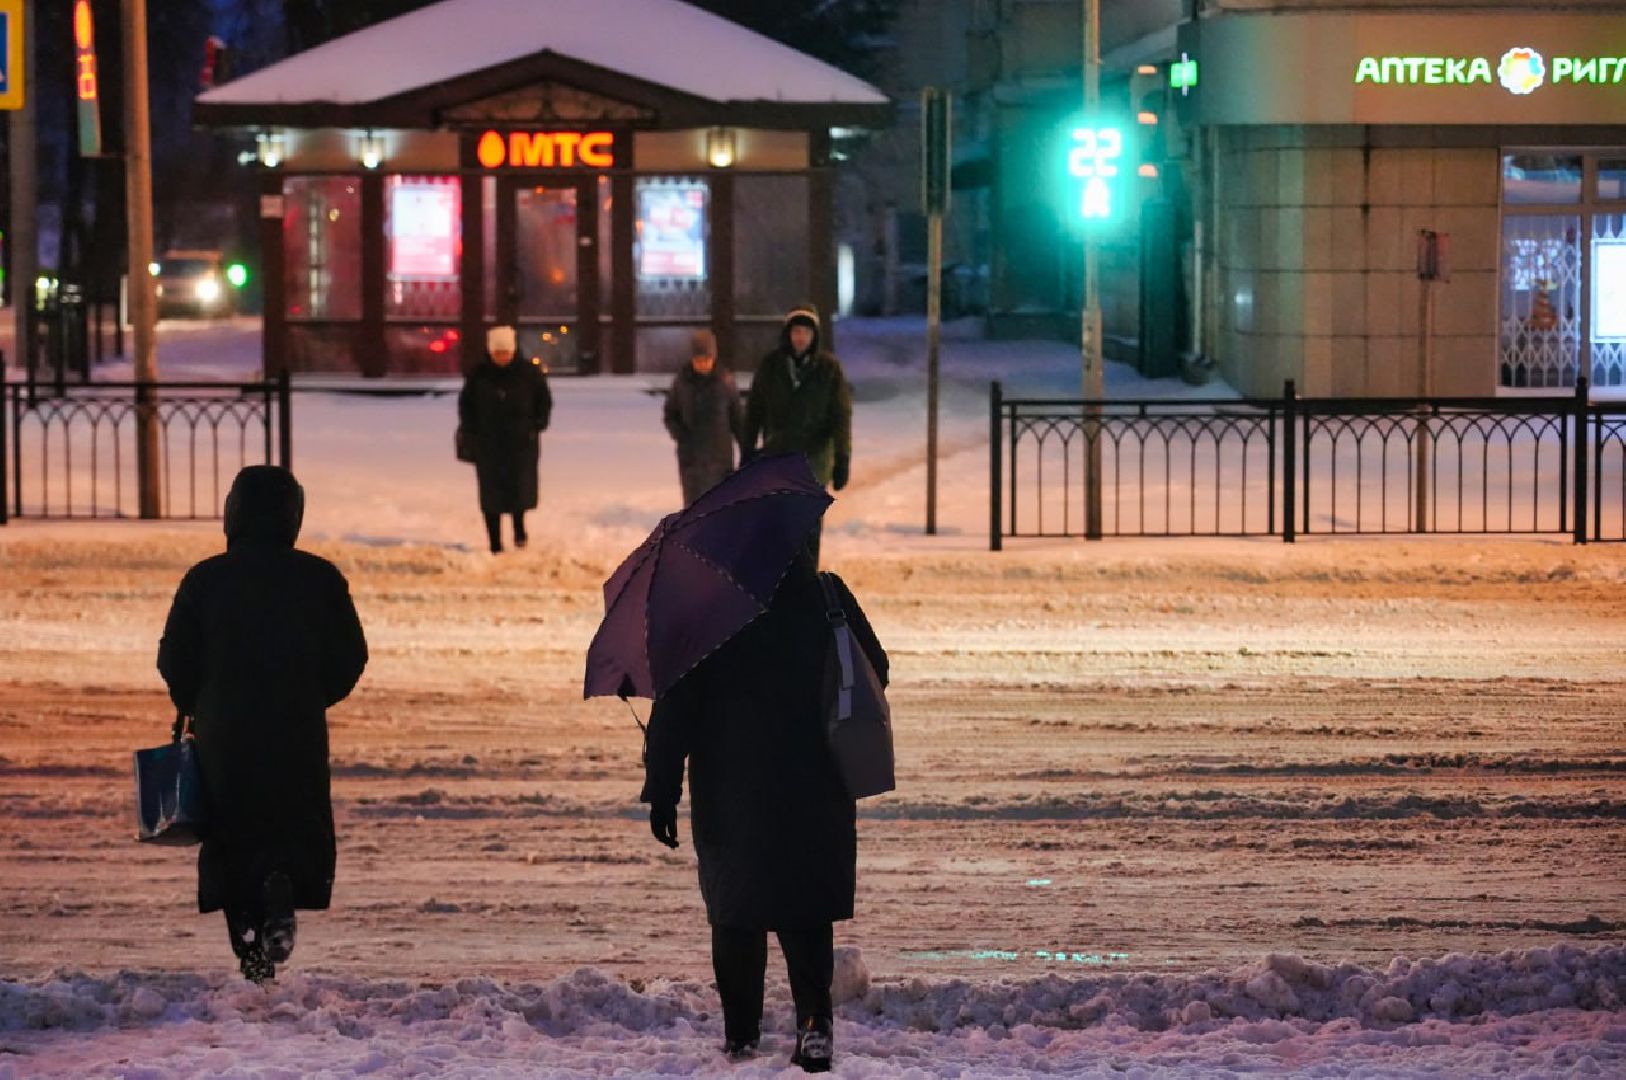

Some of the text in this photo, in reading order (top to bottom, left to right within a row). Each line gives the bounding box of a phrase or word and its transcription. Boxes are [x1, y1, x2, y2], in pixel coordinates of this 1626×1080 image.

[1355, 57, 1492, 84] АПТЕКА
[509, 132, 614, 167] МТС
[1069, 128, 1121, 176] 22
